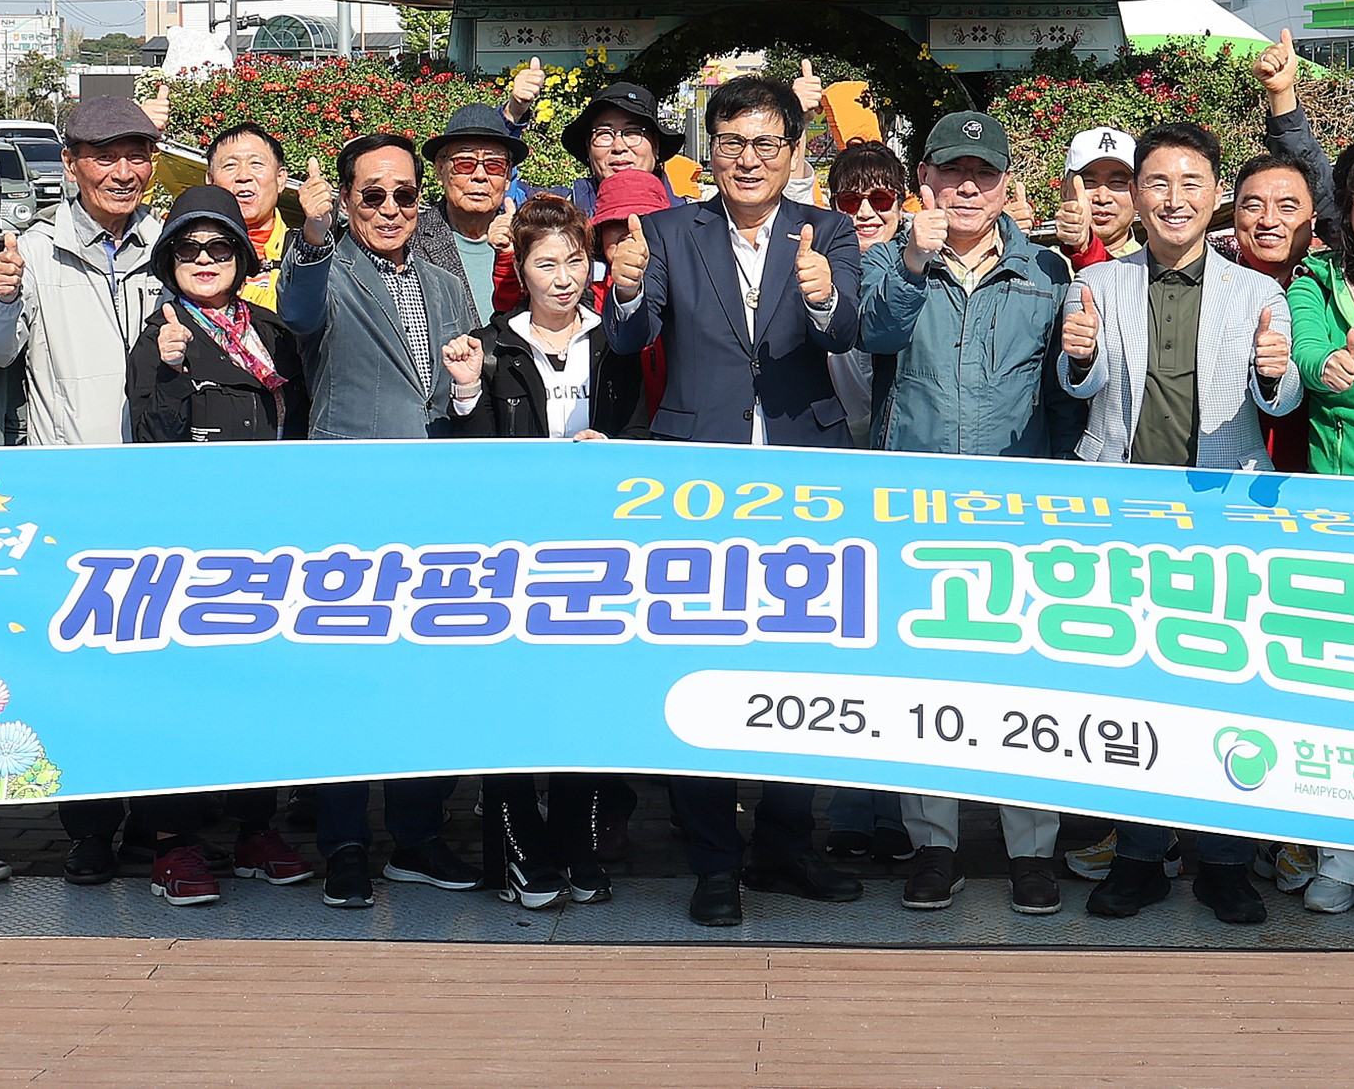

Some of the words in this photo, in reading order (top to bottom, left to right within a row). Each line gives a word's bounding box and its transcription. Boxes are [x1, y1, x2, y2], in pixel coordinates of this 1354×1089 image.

[1, 14, 16, 26] NH
[147, 288, 164, 296] K2
[613, 477, 846, 523] 2025
[873, 487, 1195, 530] 대한민국
[55, 541, 870, 645] 재경함평군민회
[745, 693, 881, 738] 2025.
[909, 703, 978, 747] 10.
[1001, 710, 1160, 771] 26.(일)
